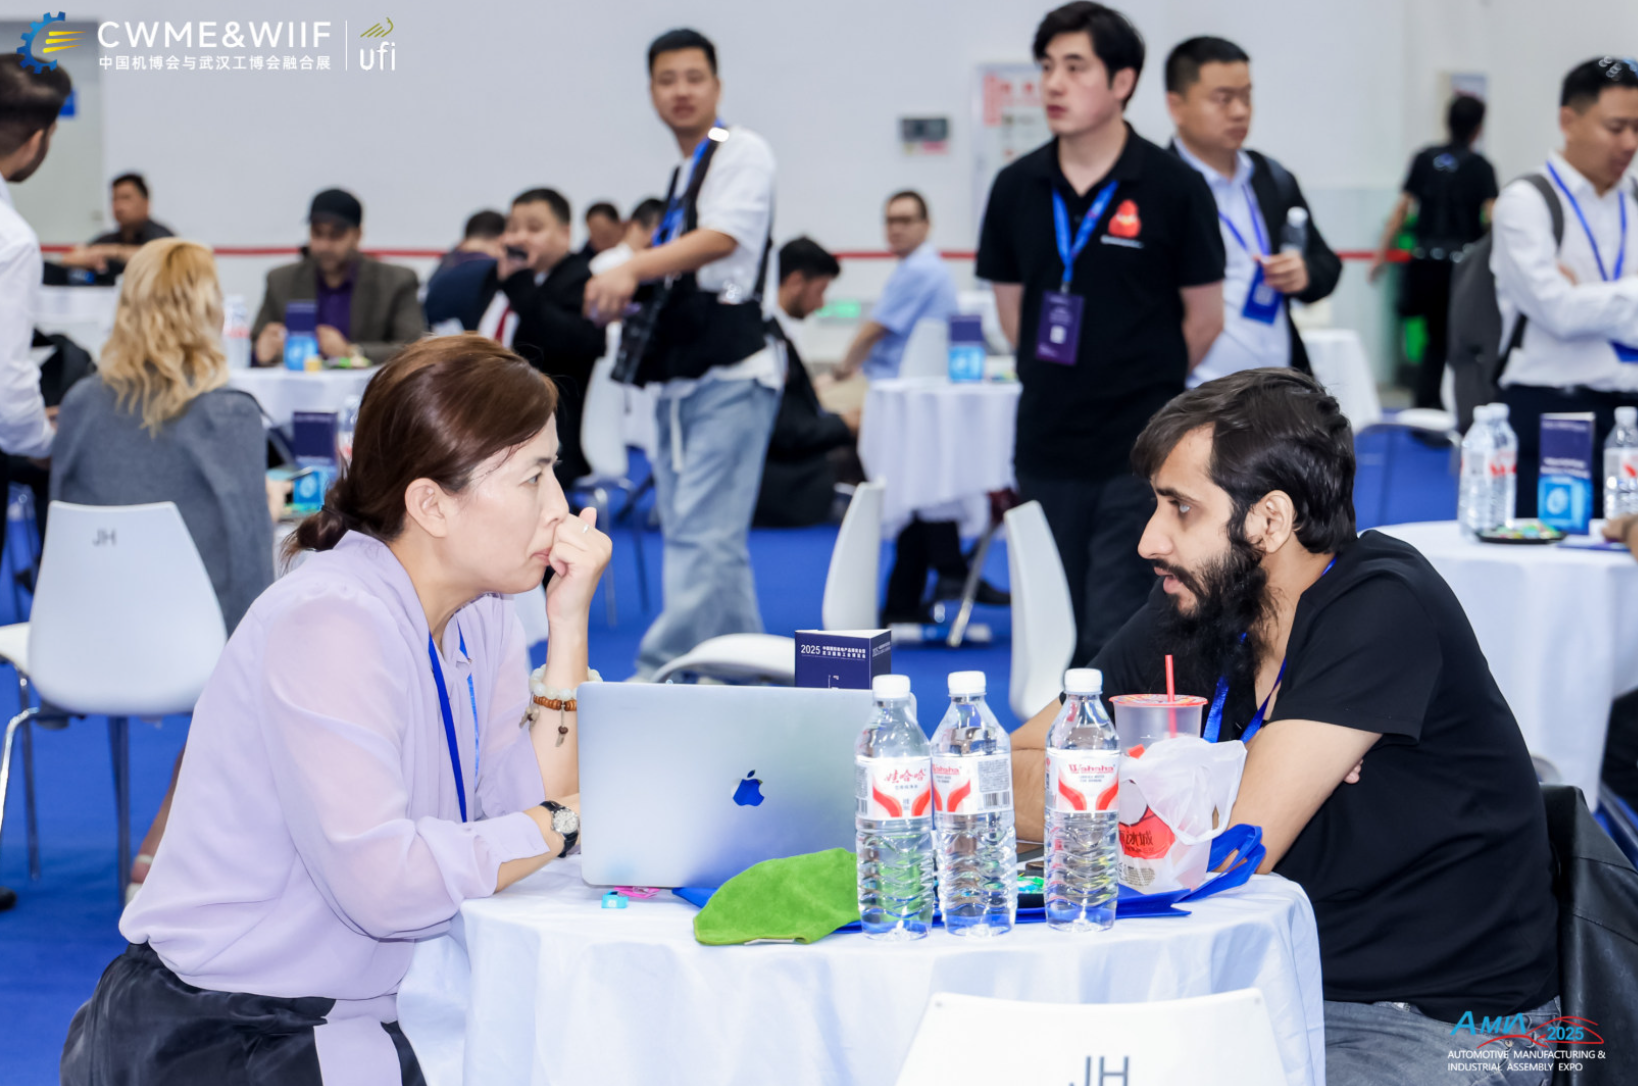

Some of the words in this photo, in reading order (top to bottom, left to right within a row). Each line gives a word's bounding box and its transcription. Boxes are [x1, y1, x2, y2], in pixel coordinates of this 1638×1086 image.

[800, 644, 820, 655] 2025
[1069, 764, 1114, 774] Wahaha
[1069, 1056, 1129, 1086] JH
